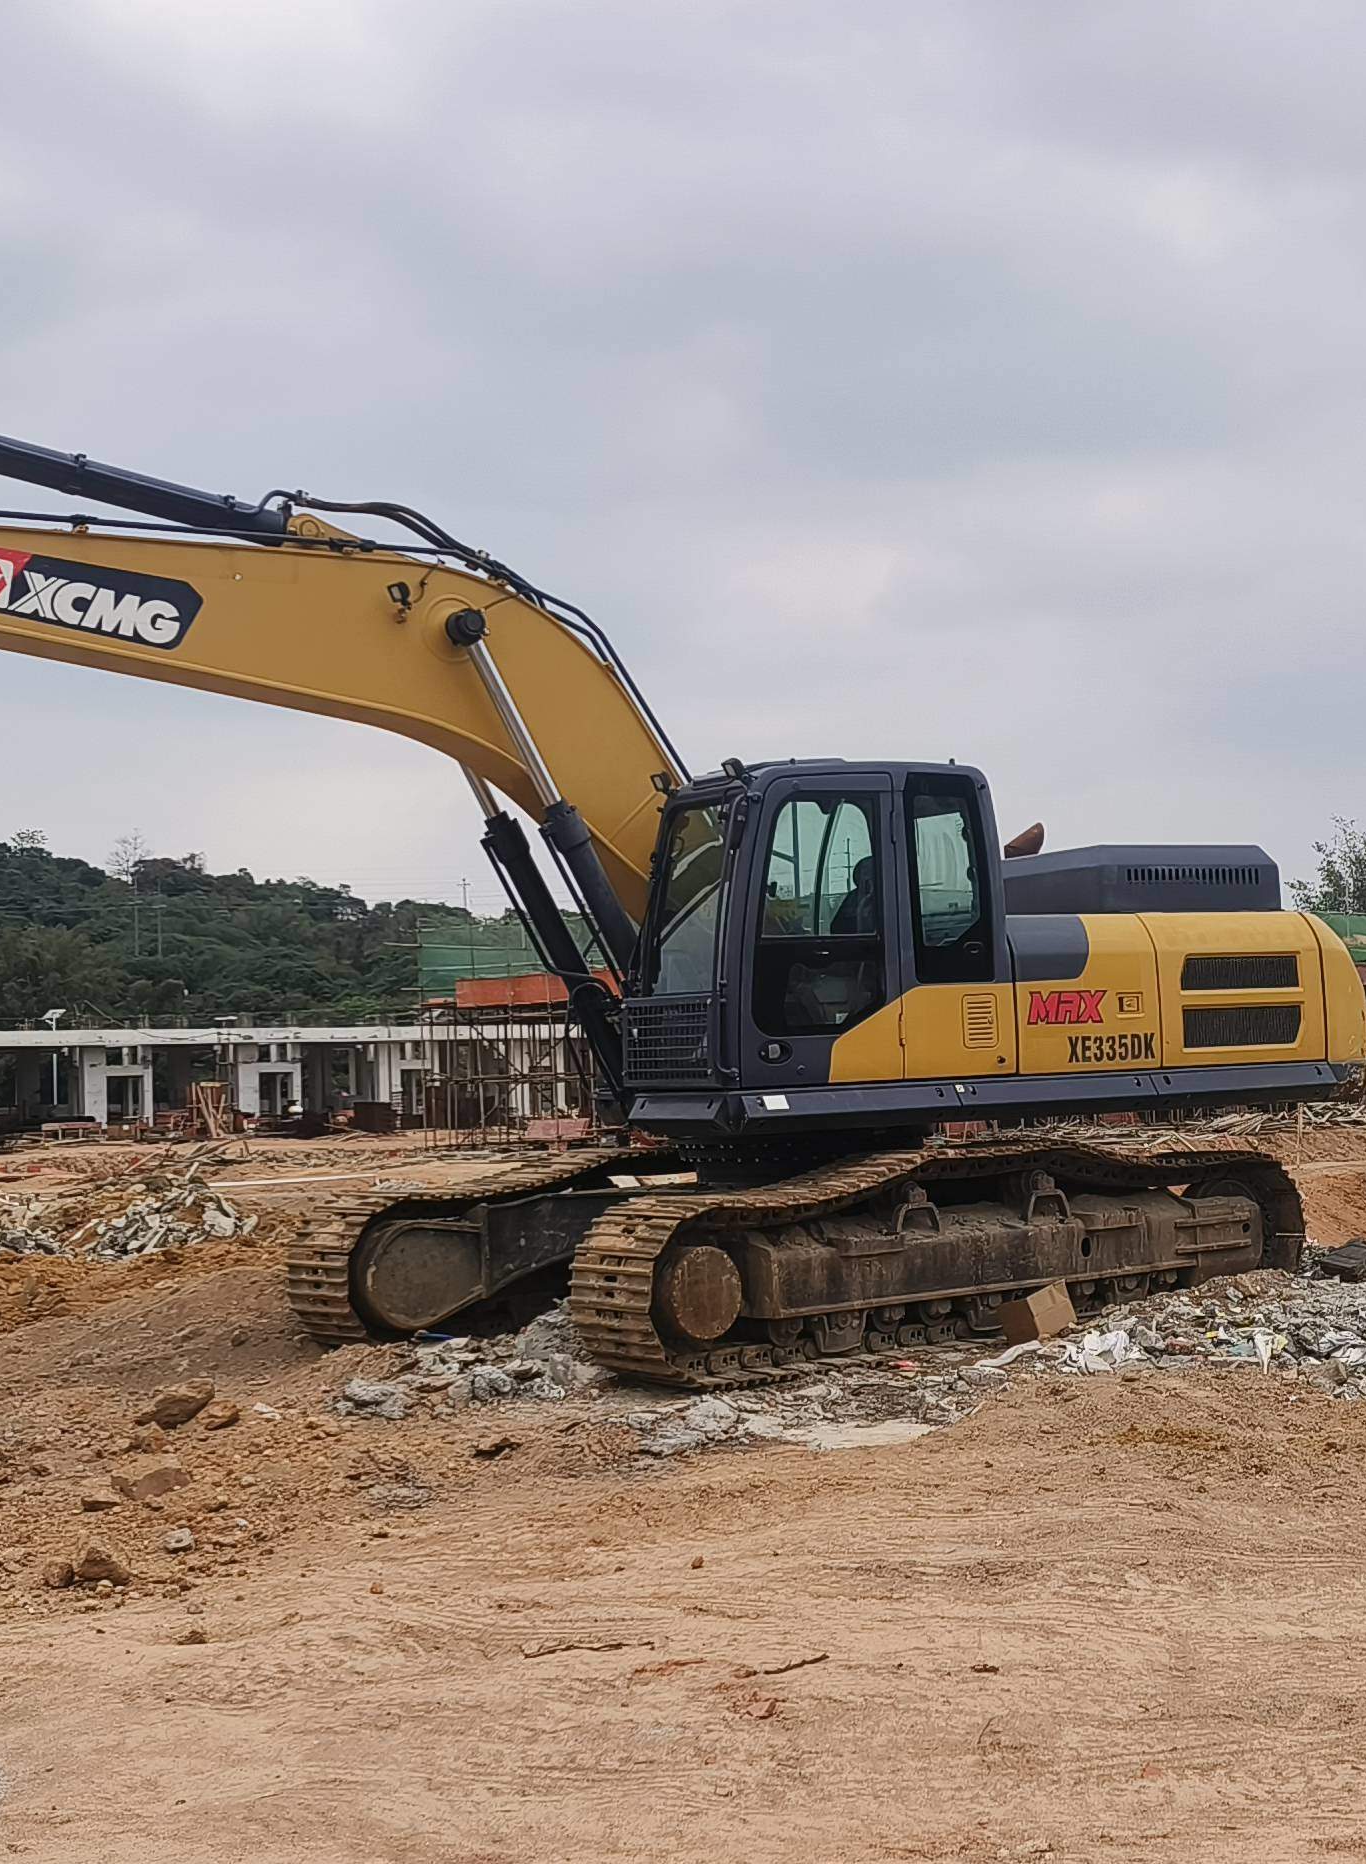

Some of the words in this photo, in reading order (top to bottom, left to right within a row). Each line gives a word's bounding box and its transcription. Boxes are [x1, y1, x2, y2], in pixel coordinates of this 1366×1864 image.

[8, 570, 180, 644] XCMG
[1027, 990, 1107, 1025] MAX
[1067, 1032, 1155, 1063] XE335DK
